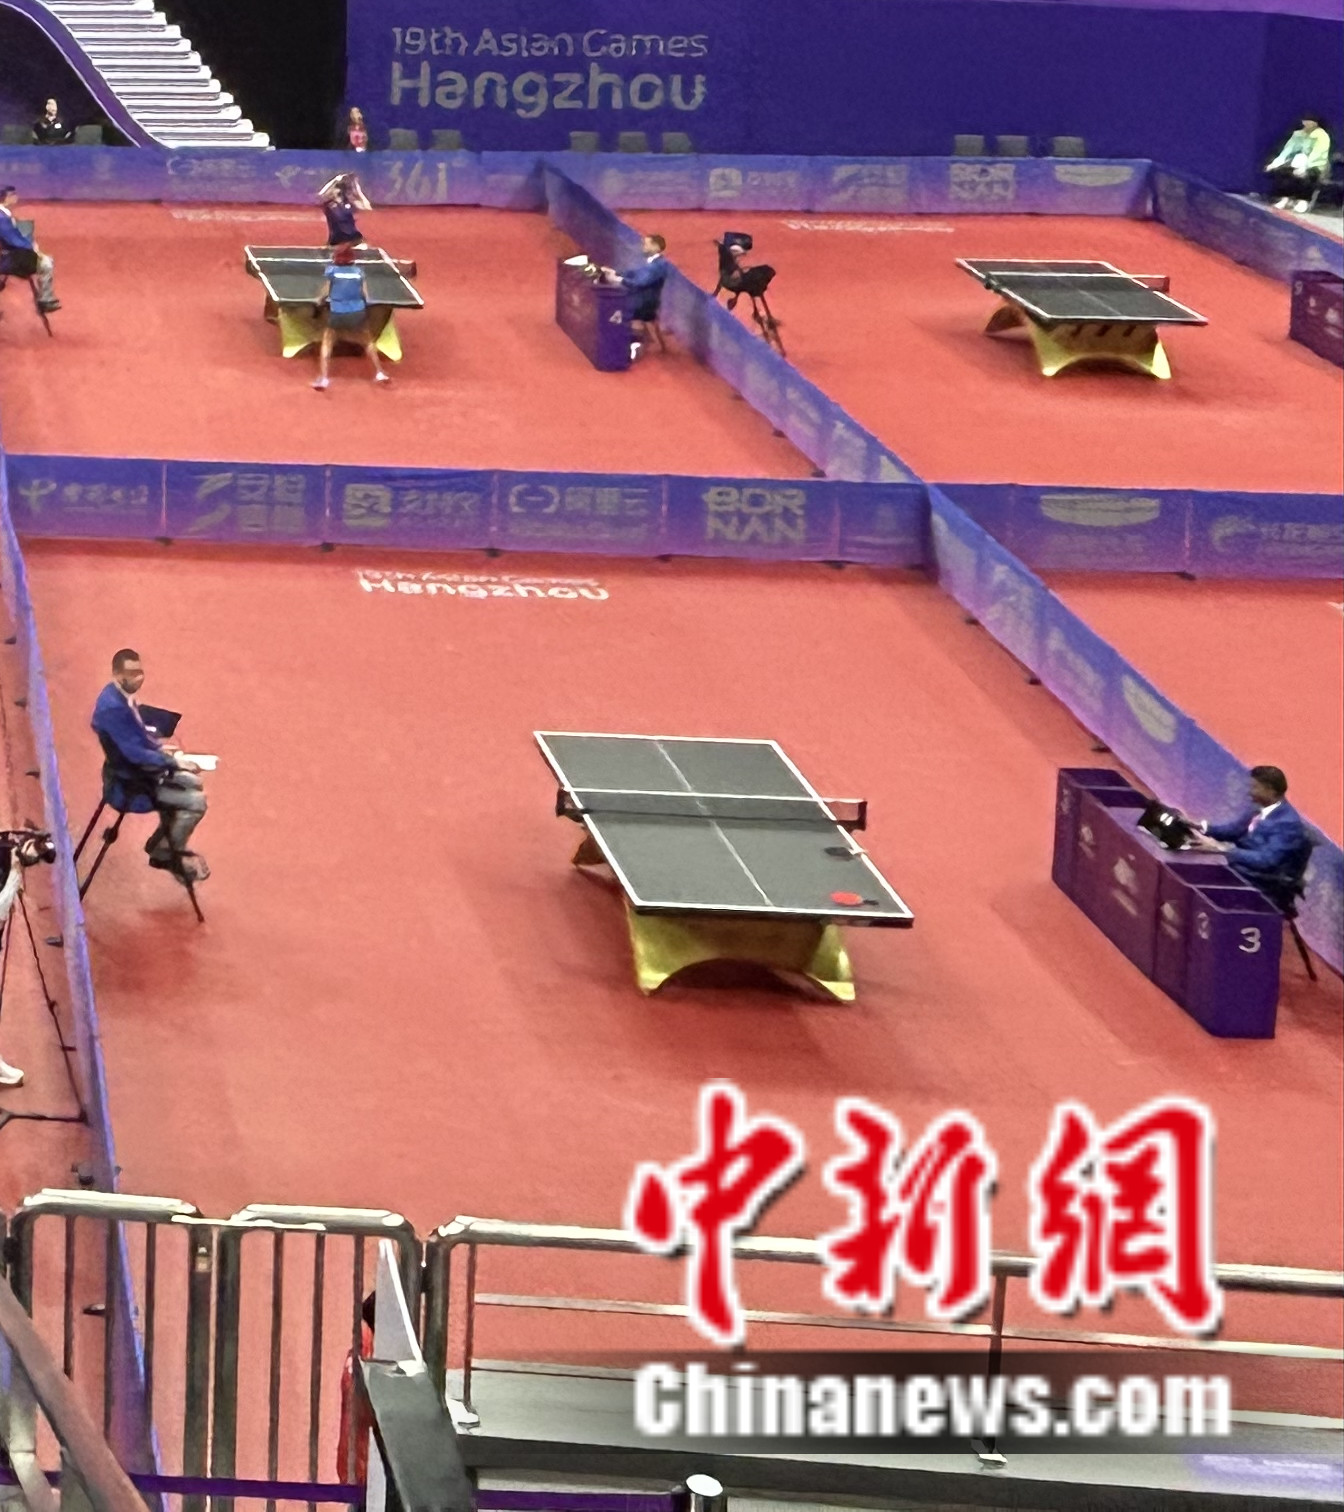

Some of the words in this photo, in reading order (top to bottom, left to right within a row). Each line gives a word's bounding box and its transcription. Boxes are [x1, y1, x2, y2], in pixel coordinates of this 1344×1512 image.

[391, 26, 469, 56] 19th
[473, 28, 574, 58] Asian
[582, 29, 709, 58] Games
[389, 60, 709, 119] Hangzhou
[701, 487, 807, 514] BOR
[709, 514, 807, 544] NAN
[358, 577, 610, 600] Hangzhou
[1238, 927, 1262, 954] 3
